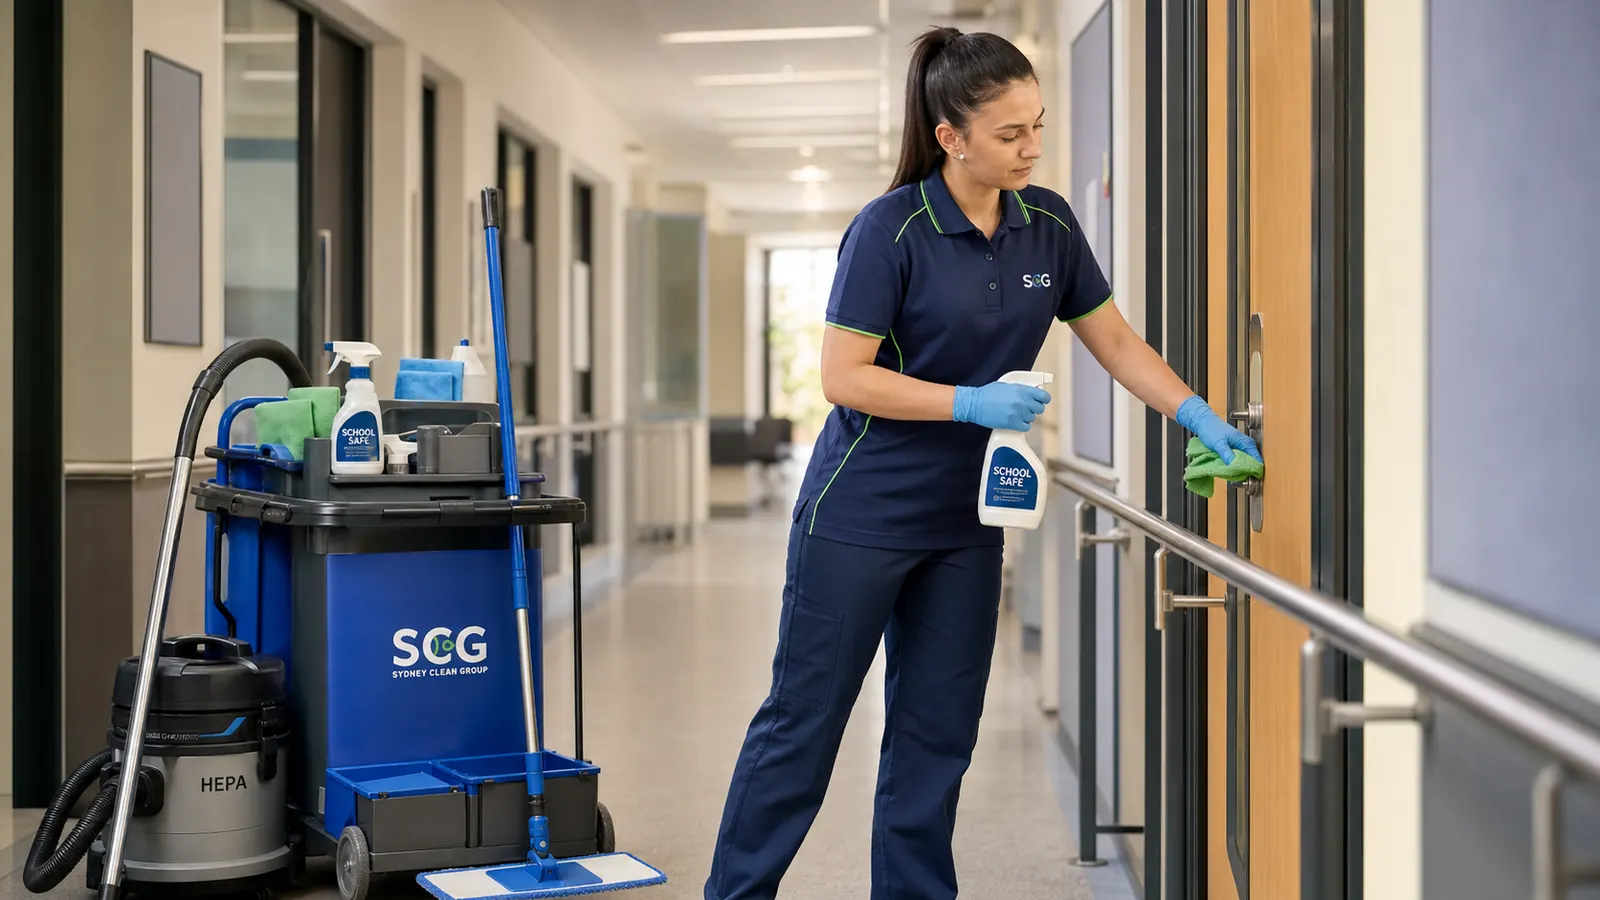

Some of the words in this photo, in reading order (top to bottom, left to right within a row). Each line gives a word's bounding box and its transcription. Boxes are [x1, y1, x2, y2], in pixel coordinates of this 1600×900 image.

[1022, 273, 1051, 288] SCG
[341, 428, 376, 437] SCHOOL
[348, 437, 370, 445] SAFE
[993, 466, 1032, 478] SCHOOL
[1000, 476, 1024, 487] SAFE
[392, 625, 488, 667] SCG
[392, 669, 427, 679] SYDNEY
[429, 667, 457, 677] CLEAN
[459, 665, 489, 675] GROUP
[201, 775, 248, 792] HEPA
